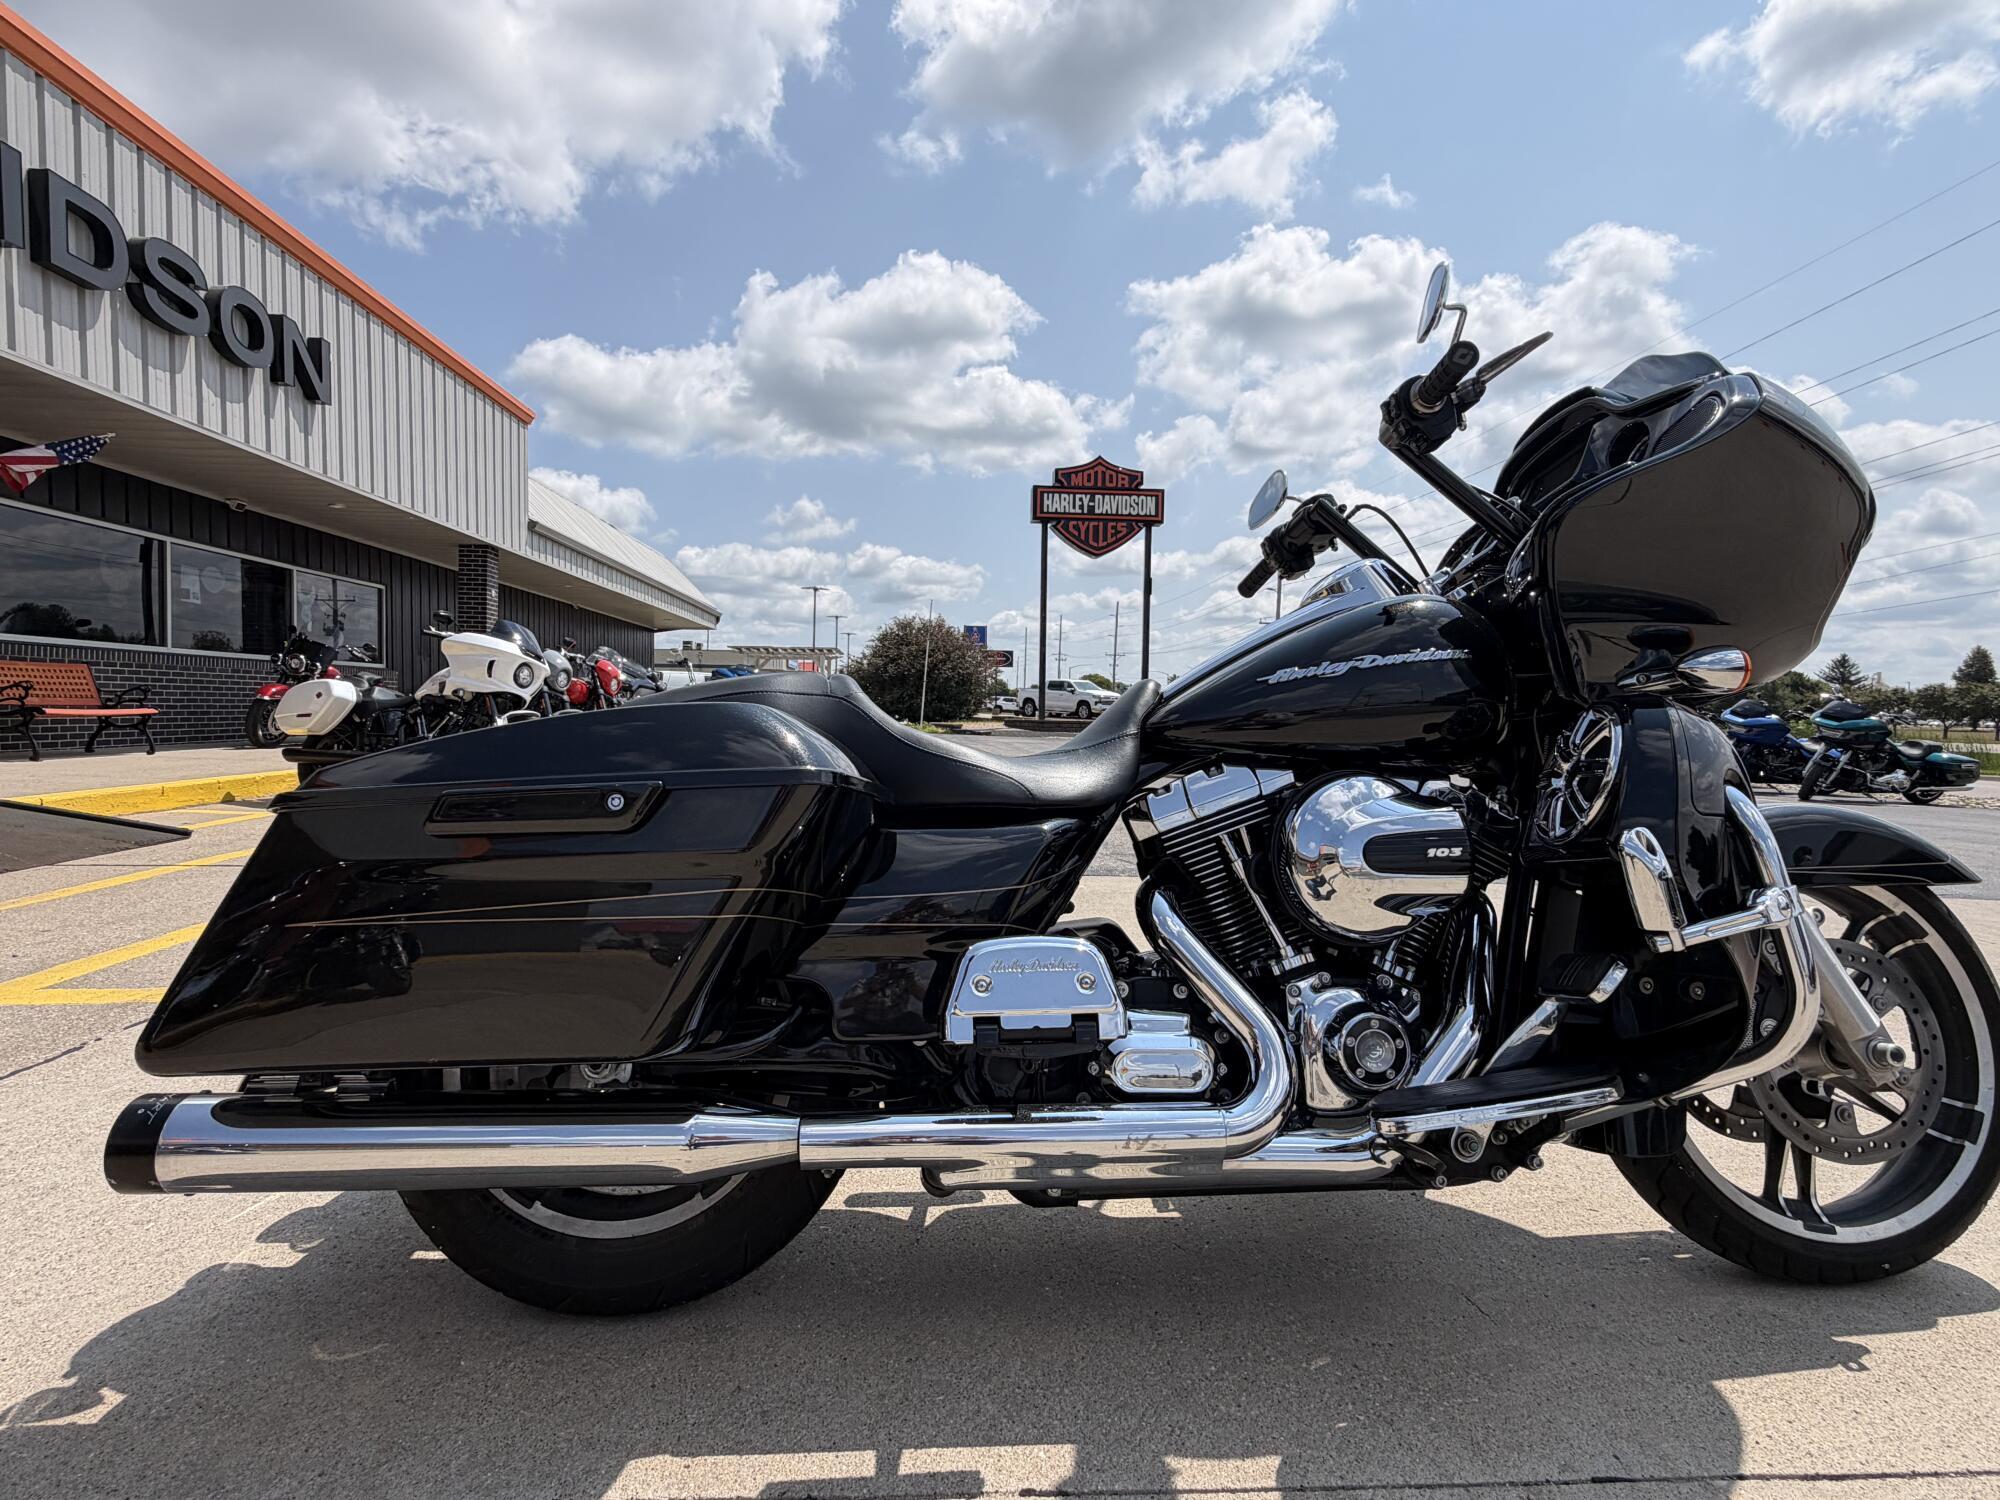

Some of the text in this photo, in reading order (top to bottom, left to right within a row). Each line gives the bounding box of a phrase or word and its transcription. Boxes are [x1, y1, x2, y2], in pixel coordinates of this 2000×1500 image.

[1070, 464, 1129, 488] MOTOR
[1043, 492, 1156, 516] HARLEY-DAVIDSON
[1068, 521, 1128, 547] CYCLES
[1256, 647, 1473, 685] Harley-Davidson
